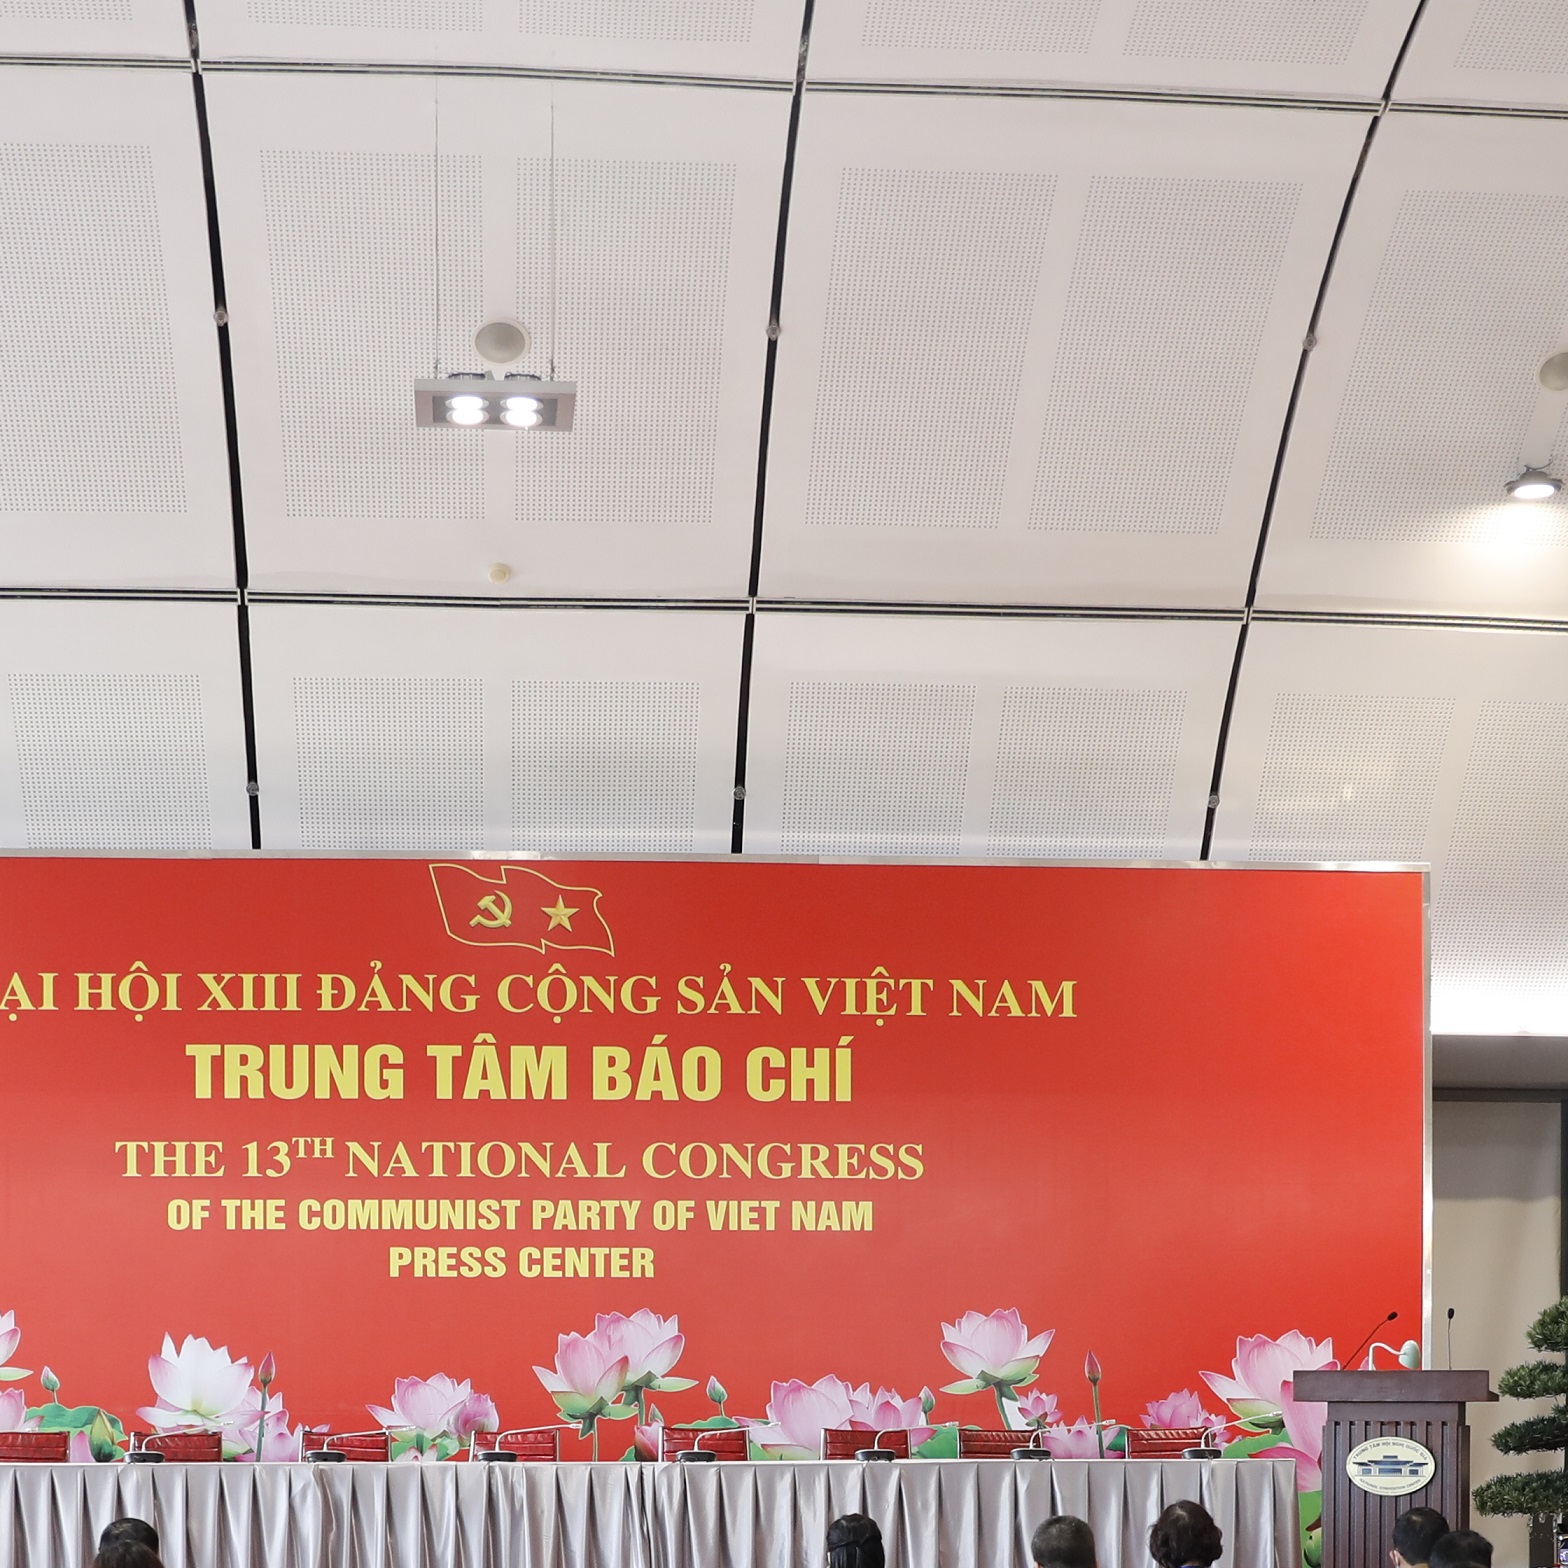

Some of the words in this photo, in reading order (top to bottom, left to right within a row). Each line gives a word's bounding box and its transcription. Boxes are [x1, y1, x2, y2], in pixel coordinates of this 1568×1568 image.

[73, 961, 183, 1022] HỘI
[196, 973, 303, 1011] XIII
[316, 961, 481, 1012] ĐẢNG
[497, 963, 658, 1024] CỘNG
[676, 963, 785, 1015] SẢN
[800, 966, 934, 1027] VIỆT
[948, 979, 1078, 1018] NAM
[185, 1043, 404, 1100] TRUNG
[426, 1033, 568, 1100] TÂM
[592, 1034, 722, 1102] BÁO
[746, 1035, 855, 1103] CHÍ
[114, 1141, 226, 1178] THE
[241, 1136, 335, 1178] 13TH
[344, 1140, 627, 1179] NATIONAL
[641, 1141, 925, 1181] CONGRESS
[167, 1198, 211, 1231] OF
[220, 1198, 287, 1231] THE
[298, 1198, 521, 1231] COMMUNIST
[532, 1199, 642, 1231] PARTY
[652, 1199, 696, 1232] OF
[705, 1199, 781, 1231] VIET
[791, 1200, 873, 1232] NAM
[389, 1245, 507, 1279] PRESS
[518, 1246, 655, 1279] CENTER
